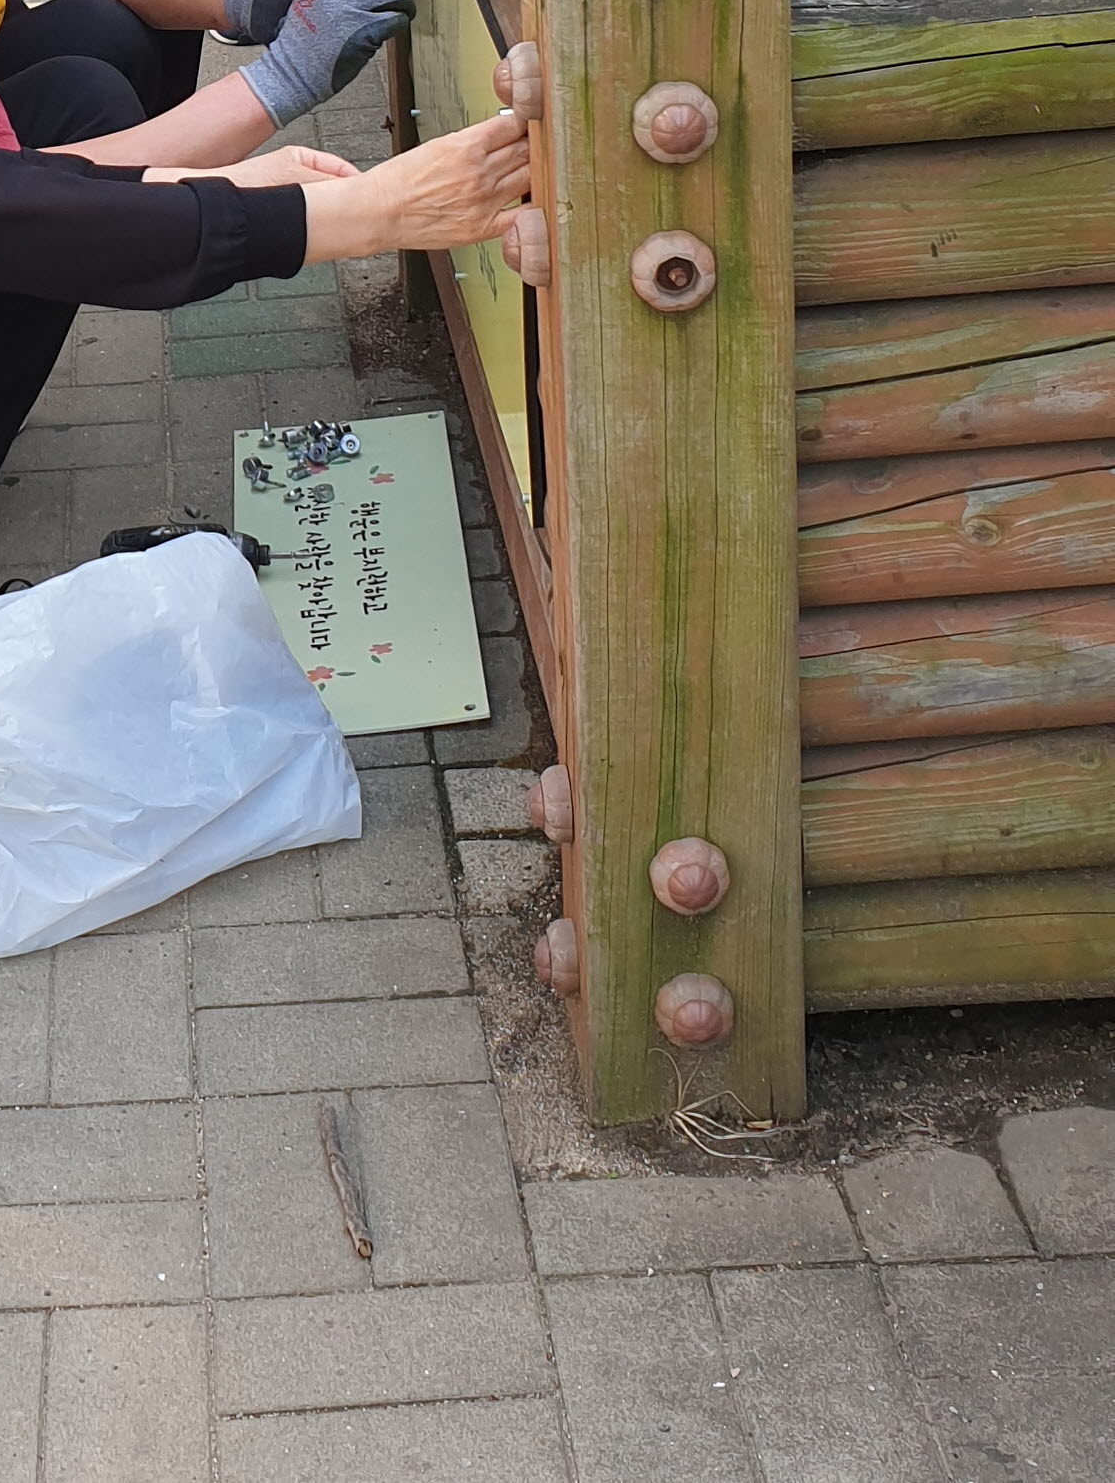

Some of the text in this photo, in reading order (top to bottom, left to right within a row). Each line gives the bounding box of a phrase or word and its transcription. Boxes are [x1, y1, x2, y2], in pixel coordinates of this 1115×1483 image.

[294, 532, 334, 572] 사람을
[349, 501, 388, 615] 행운은 부지런하고
[298, 575, 338, 651] 찾아갑니다
